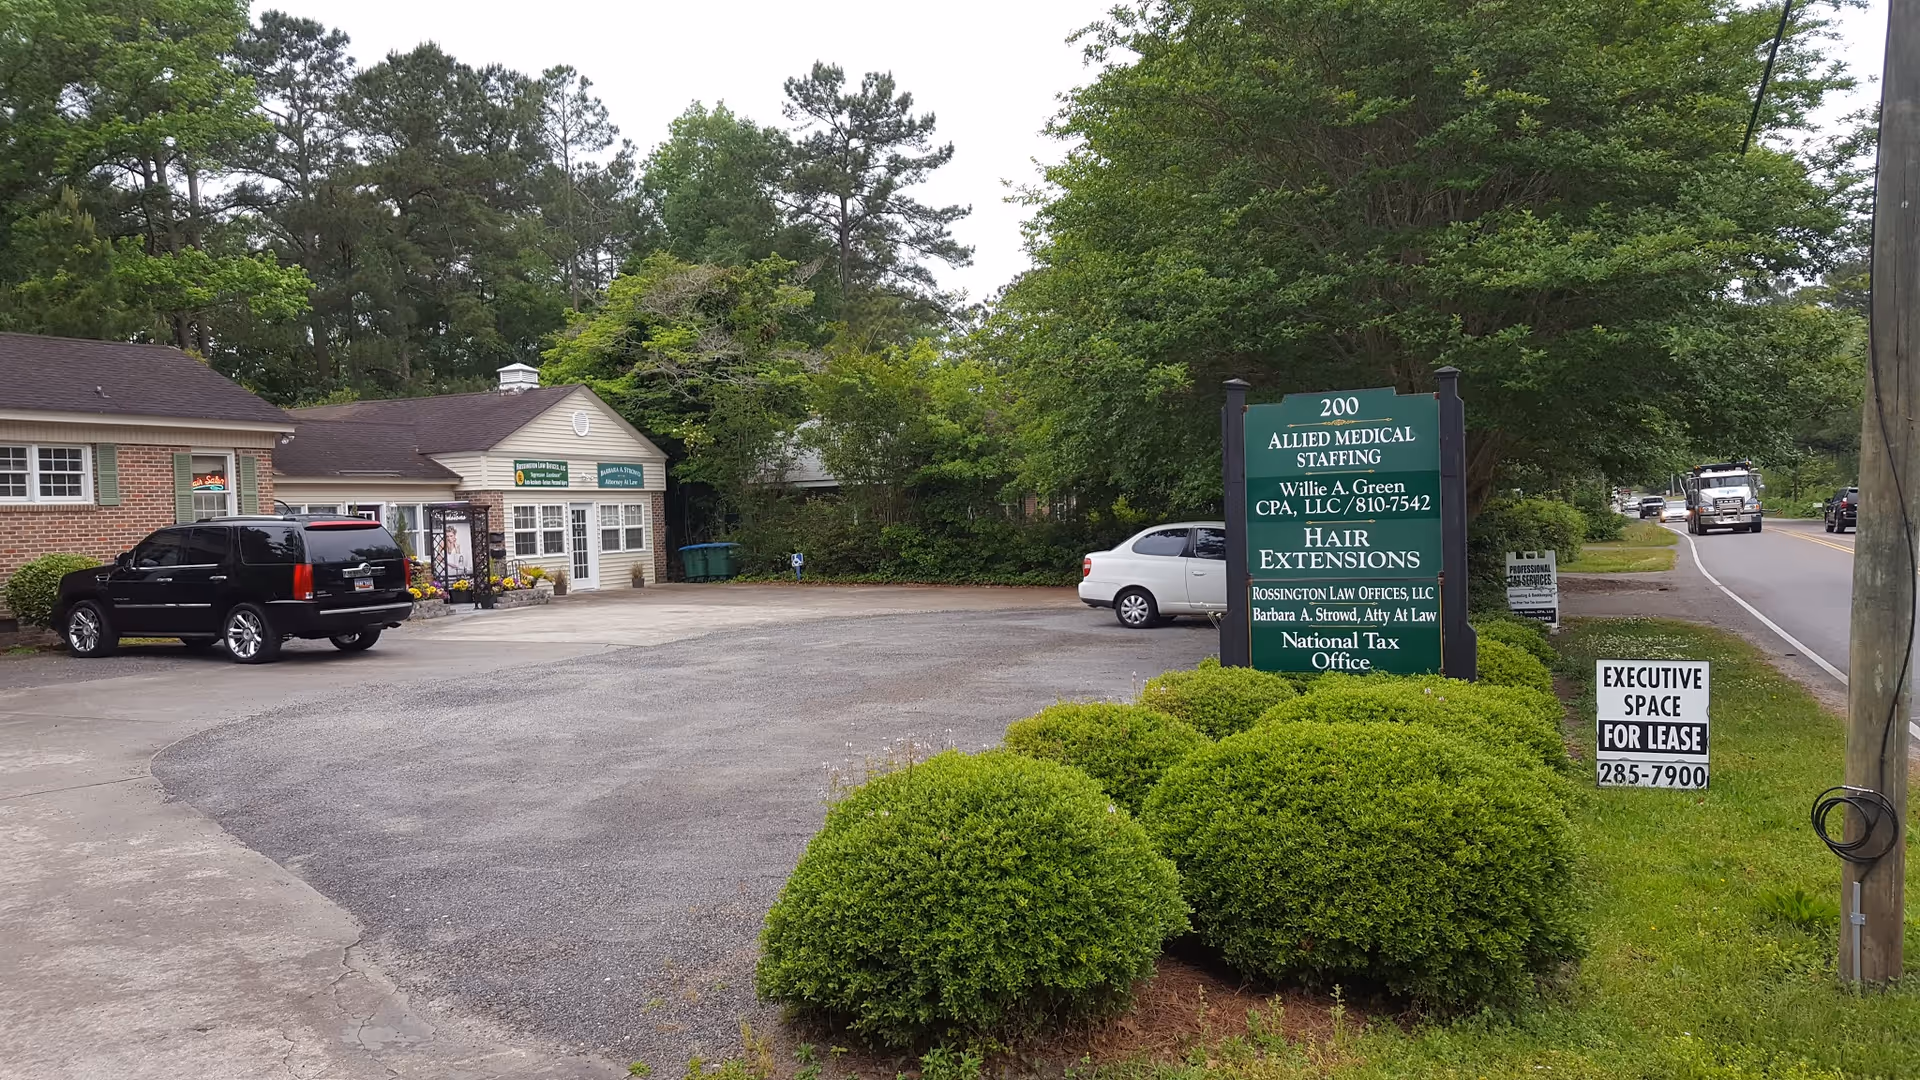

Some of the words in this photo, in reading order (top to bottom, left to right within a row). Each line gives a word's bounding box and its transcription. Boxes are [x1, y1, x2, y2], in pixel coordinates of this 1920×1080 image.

[1320, 396, 1359, 416] 200
[1268, 432, 1330, 450] ALLIED
[1334, 426, 1416, 446] MEDICAL
[1296, 449, 1382, 468] STAFFING
[1279, 480, 1328, 497] Willie
[1331, 481, 1350, 496] A.
[1352, 478, 1406, 494] Green
[1256, 500, 1298, 517] CPA,
[1303, 527, 1370, 548] HAIR
[1259, 549, 1420, 569] EXTENSIONS
[1509, 564, 1551, 574] PROFESSIONAL
[1522, 574, 1552, 586] SERVICES
[1252, 586, 1326, 600] ROSSINGTON
[1330, 586, 1355, 600] LAW
[1358, 586, 1409, 601] OFFICES,
[1412, 586, 1434, 600] LLC
[1253, 608, 1296, 622] Barbara
[1300, 608, 1313, 621] A.
[1315, 607, 1361, 624] Strowd,
[1364, 608, 1390, 626] Atty
[1393, 608, 1408, 622] At
[1411, 608, 1437, 622] Law
[1281, 631, 1359, 649] National
[1362, 632, 1400, 650] Tax
[1311, 652, 1371, 670] Office
[1603, 666, 1702, 690] EXECUTIVE
[1624, 694, 1681, 717] SPACE
[1604, 724, 1641, 749] FOR
[1647, 725, 1701, 751] LEASE
[1600, 763, 1706, 787] 285-7900
